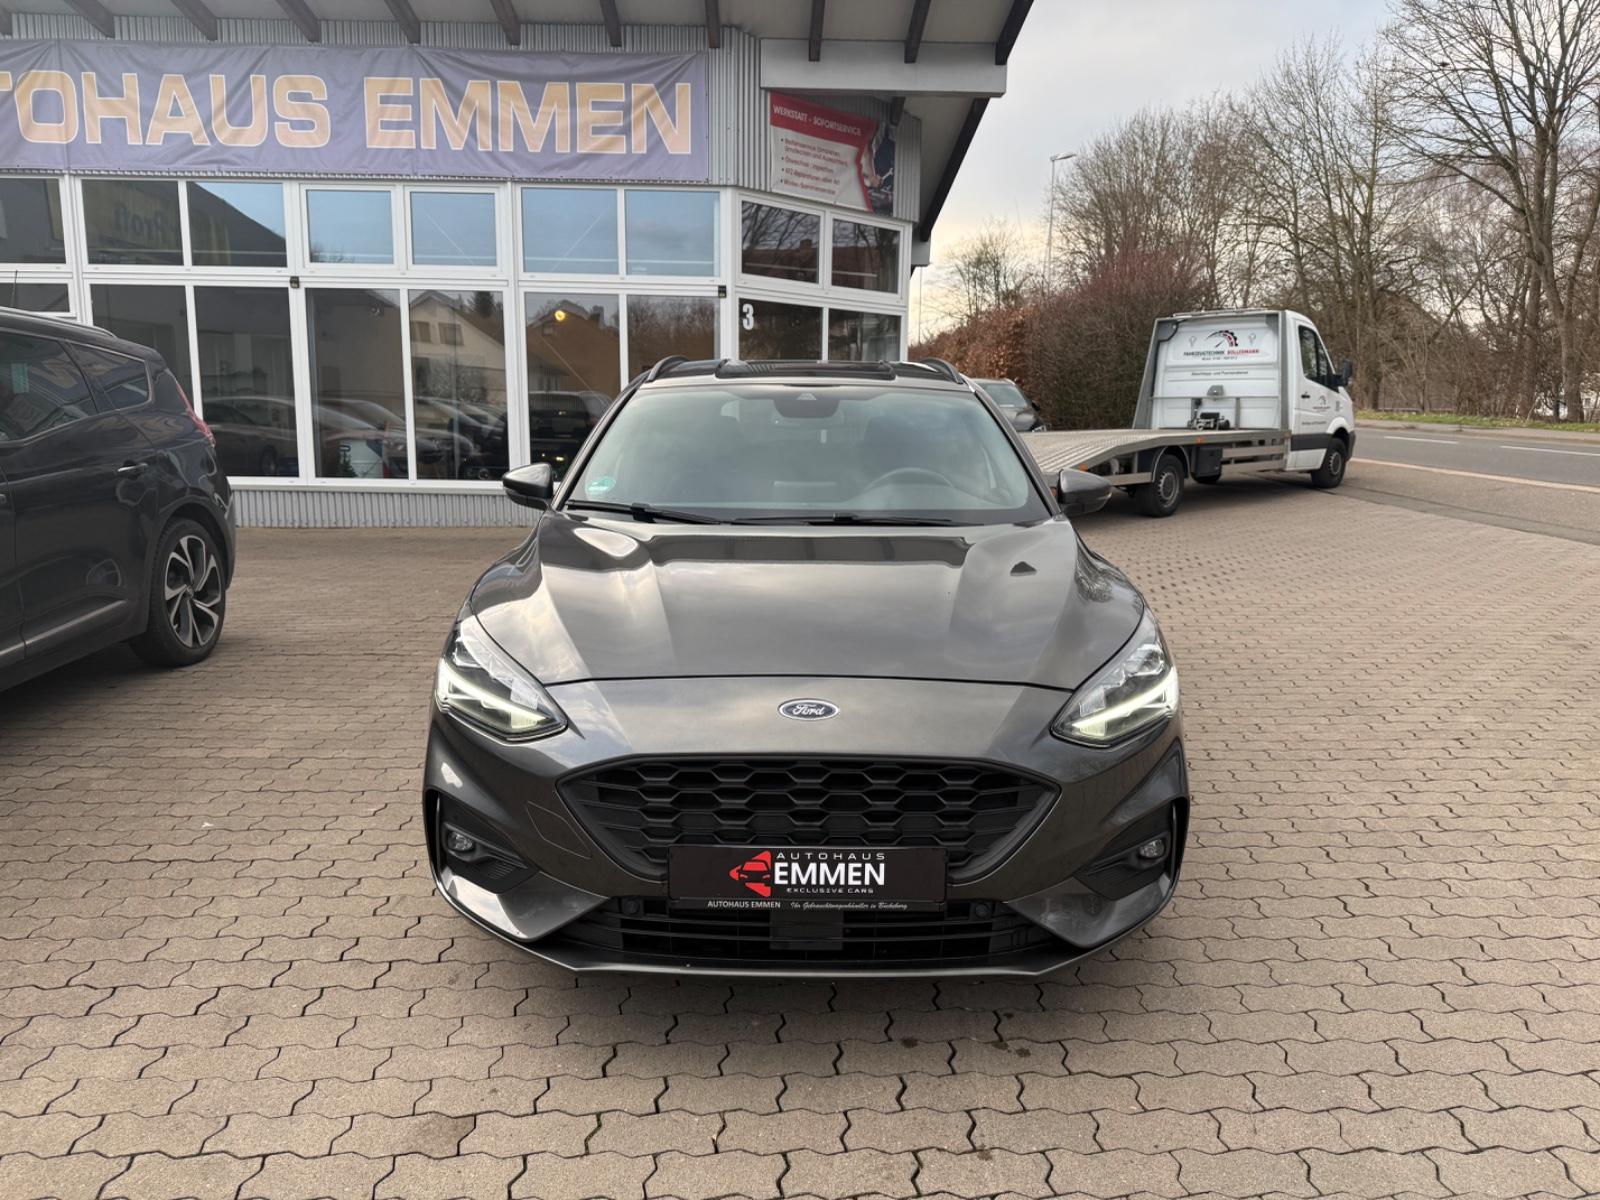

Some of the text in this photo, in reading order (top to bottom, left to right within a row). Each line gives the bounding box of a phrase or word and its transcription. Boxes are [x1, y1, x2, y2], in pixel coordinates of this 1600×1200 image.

[363, 76, 692, 155] EMMEN
[773, 105, 808, 122] WERKSTATT
[742, 303, 754, 330] 3
[792, 704, 825, 715] Ford
[776, 852, 885, 860] AUTOHAUS
[774, 862, 885, 885] EMMEN
[707, 900, 749, 909] AUTOHAUS
[751, 901, 781, 909] EMMEN
